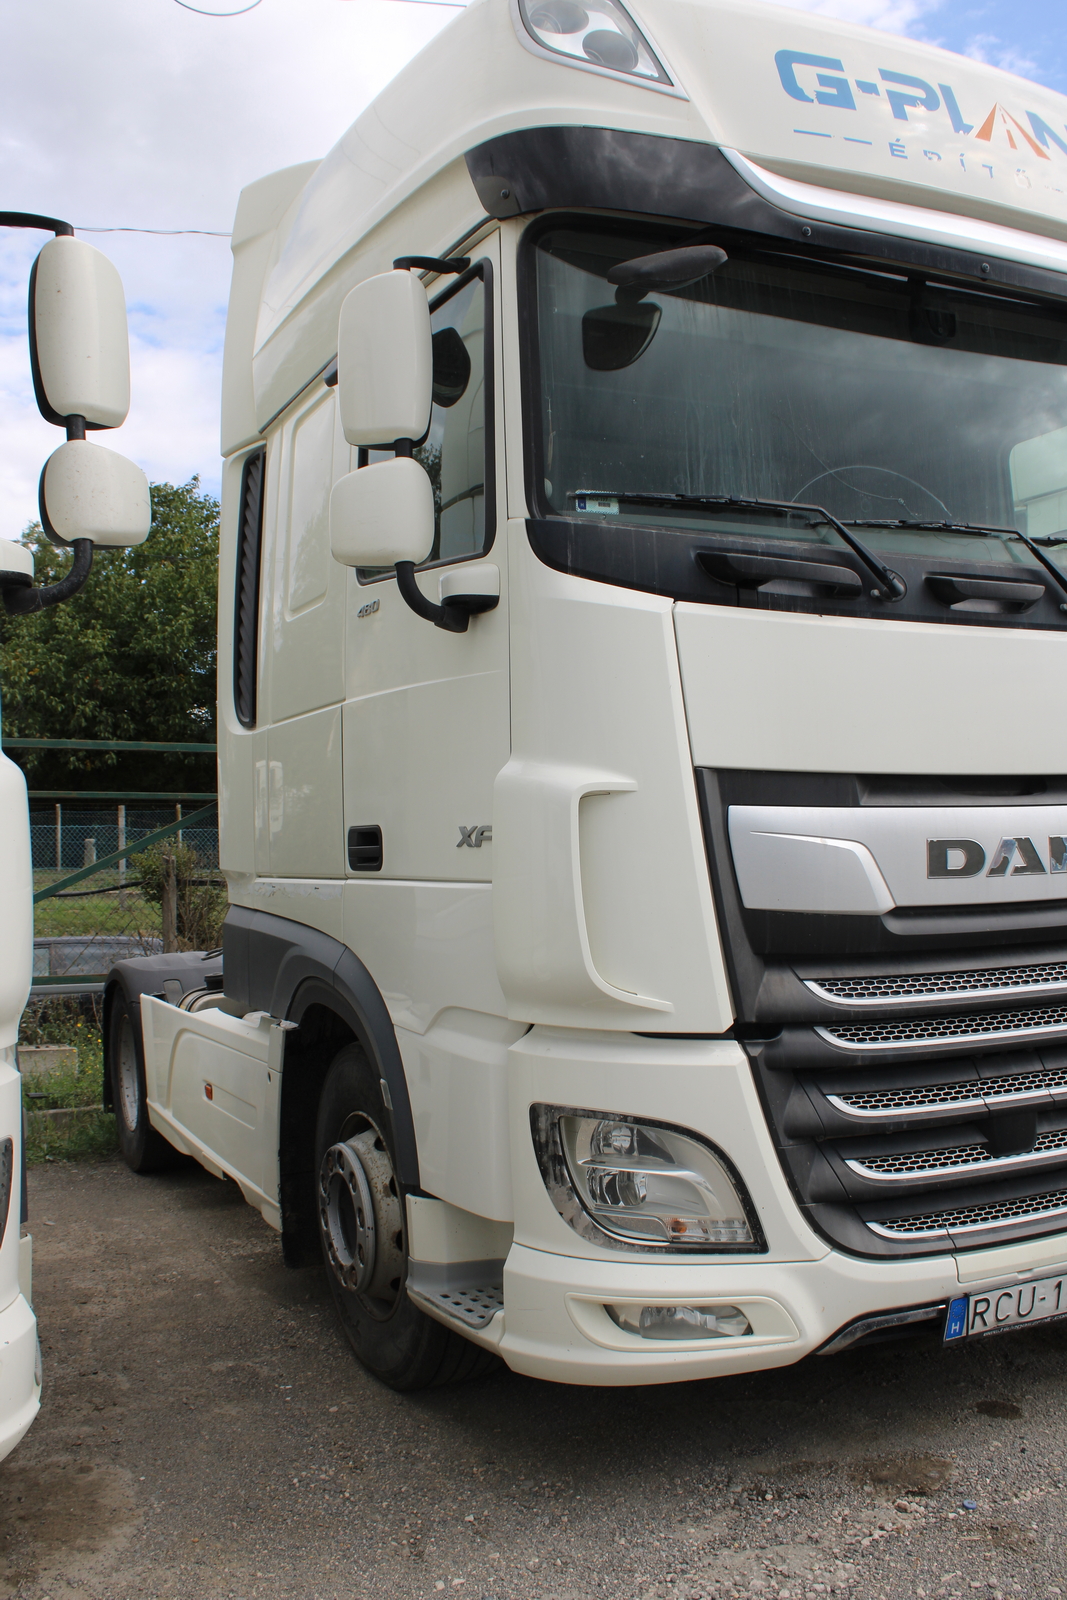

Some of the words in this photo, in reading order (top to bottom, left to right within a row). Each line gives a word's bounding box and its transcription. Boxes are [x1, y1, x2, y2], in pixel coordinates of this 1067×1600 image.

[356, 598, 380, 618] 480
[456, 825, 492, 848] XF
[951, 1322, 960, 1334] H
